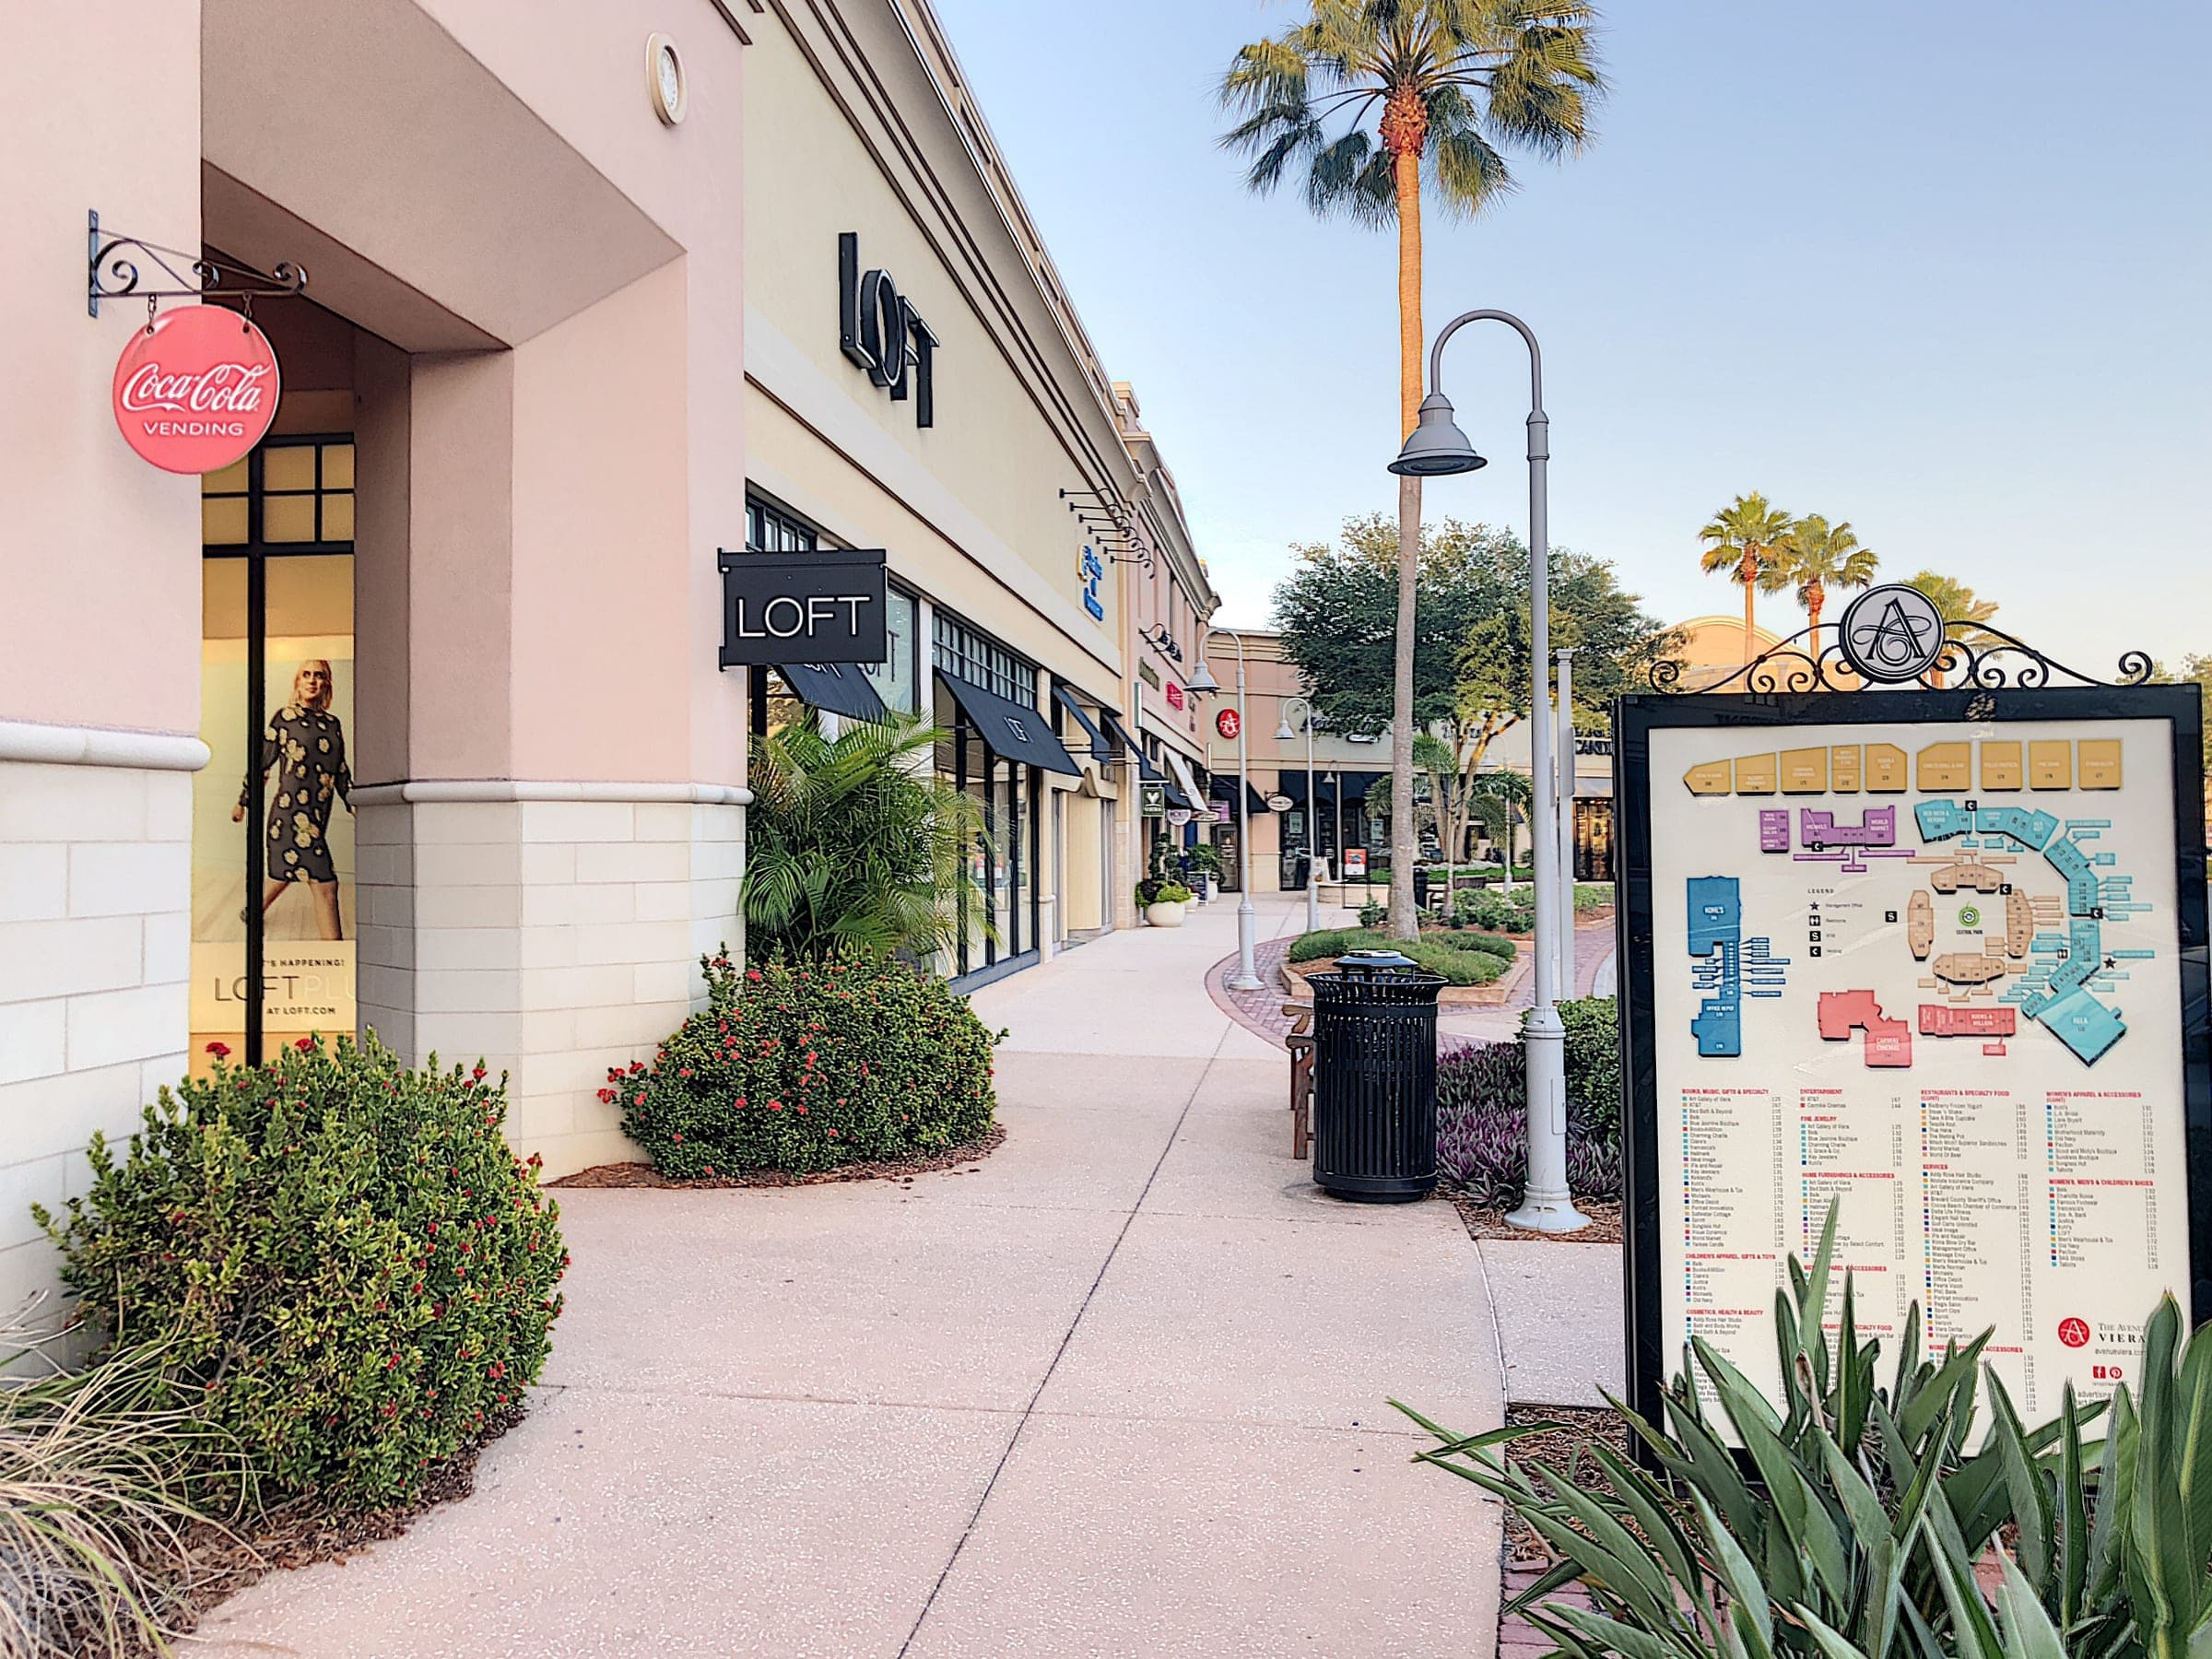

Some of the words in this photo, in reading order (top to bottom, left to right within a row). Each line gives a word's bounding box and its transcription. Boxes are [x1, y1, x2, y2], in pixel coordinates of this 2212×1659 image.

[838, 231, 940, 429] LOFT
[122, 363, 272, 412] Coca-Cola
[144, 423, 244, 435] VENDING
[739, 597, 870, 637] LOFT
